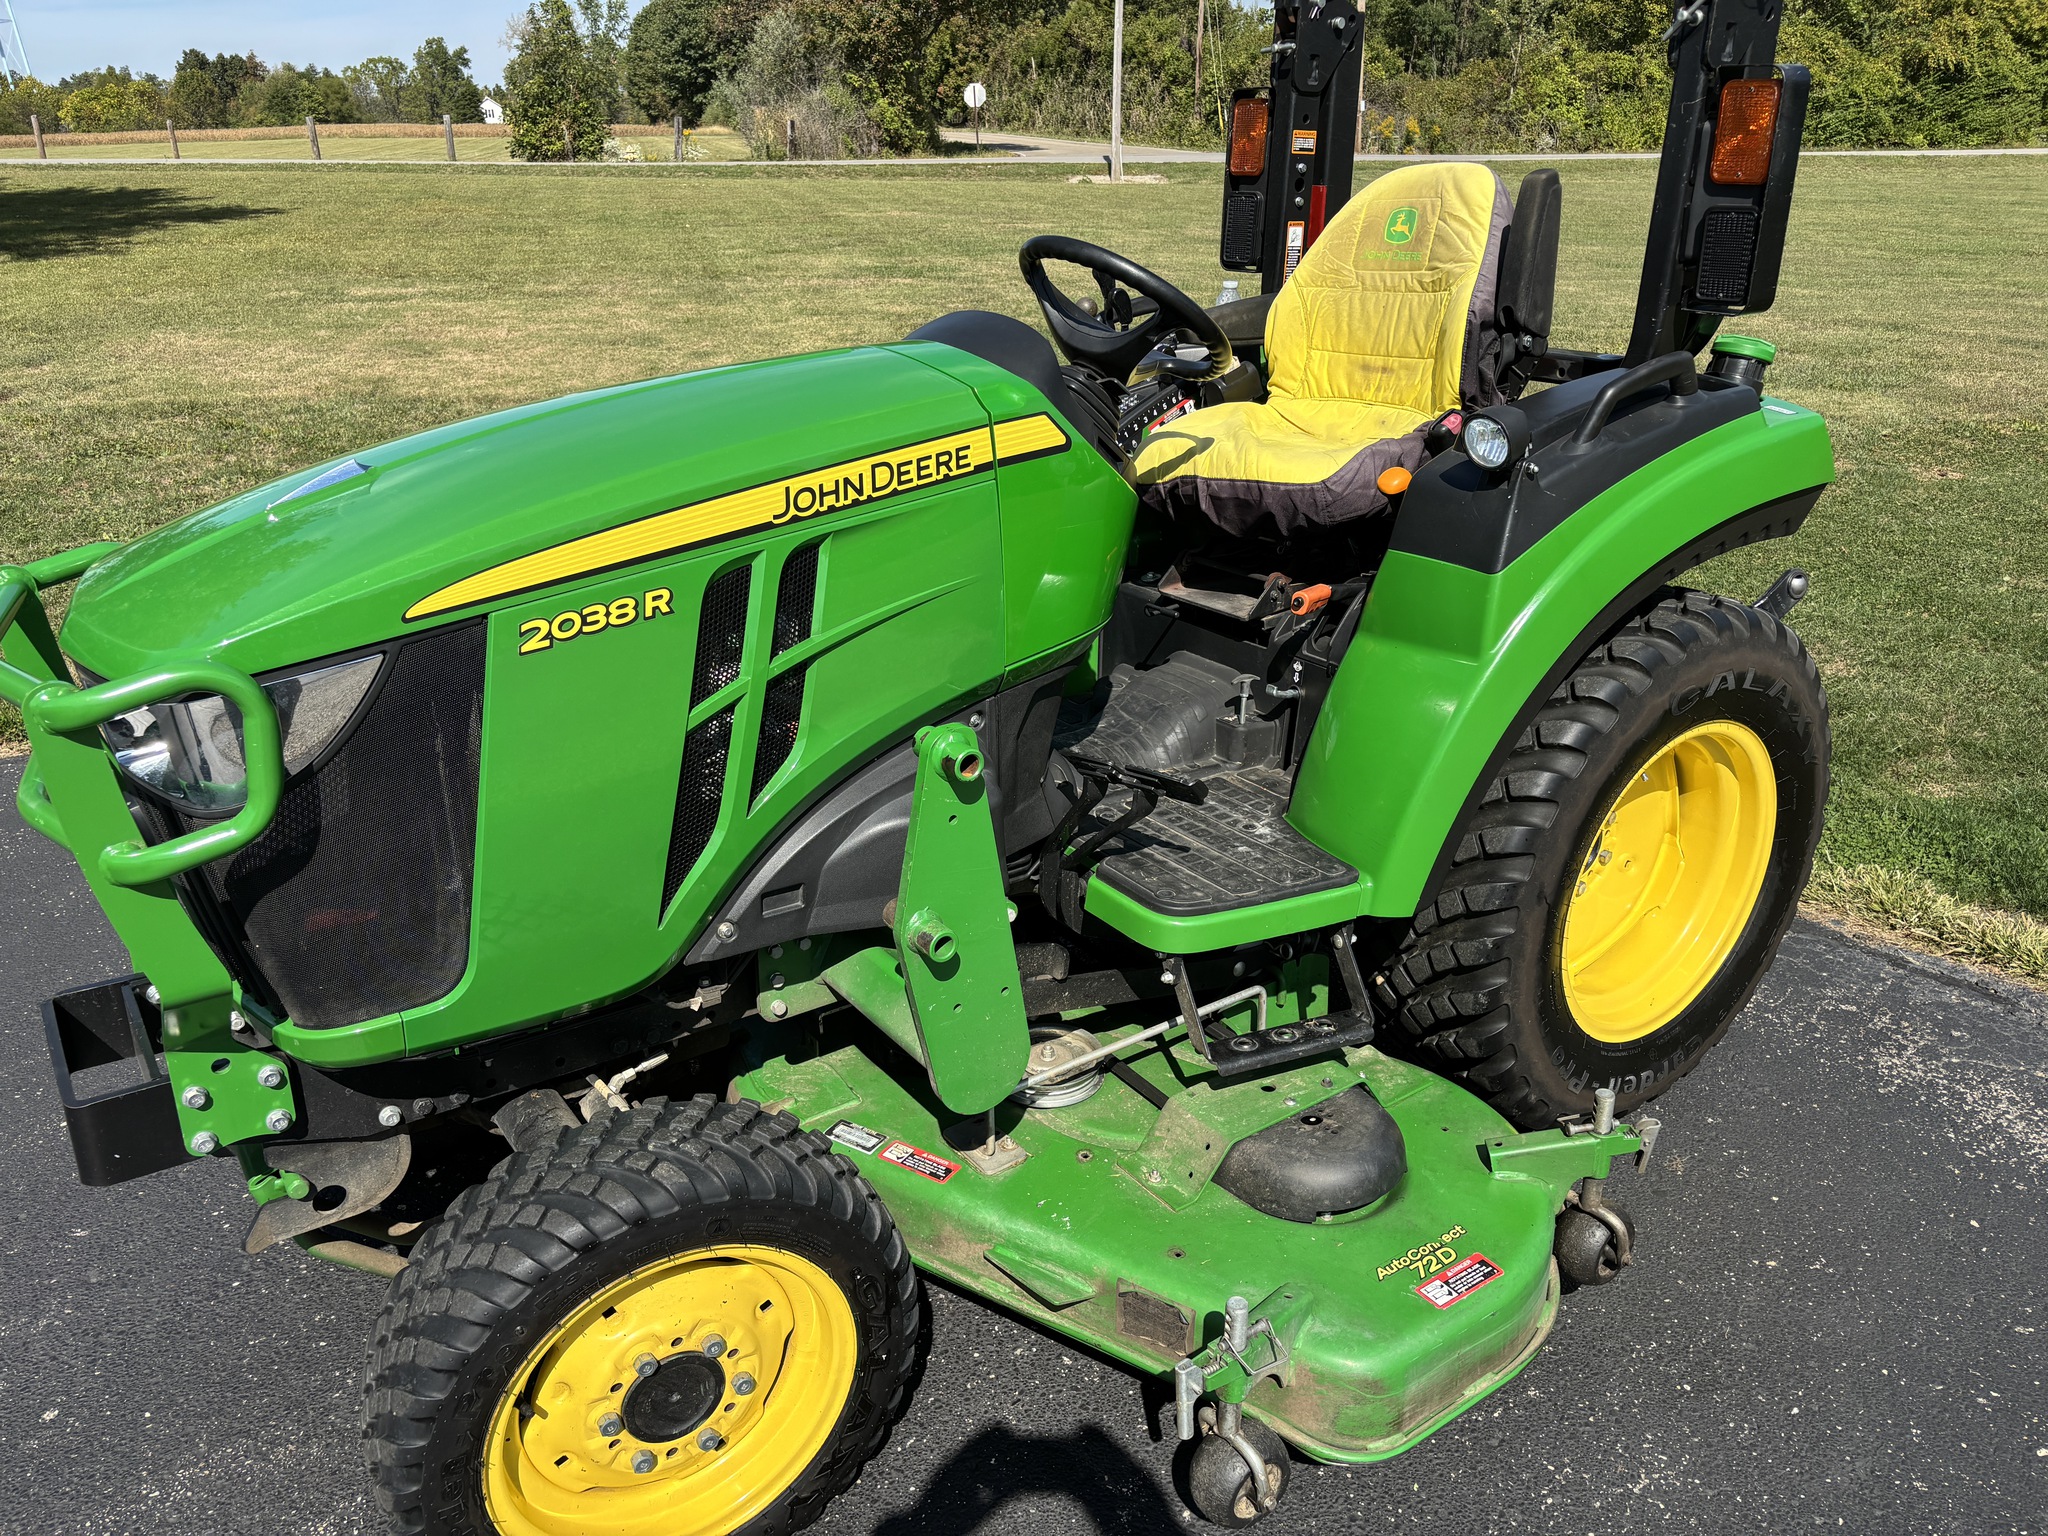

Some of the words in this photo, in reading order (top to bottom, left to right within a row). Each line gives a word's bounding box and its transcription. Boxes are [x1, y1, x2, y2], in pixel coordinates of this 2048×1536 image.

[1361, 249, 1391, 260] JOHN
[1392, 249, 1423, 261] DEERE
[1133, 423, 1139, 431] 2
[1143, 416, 1149, 424] 3
[1162, 402, 1168, 410] 5
[1171, 396, 1177, 404] 6
[772, 472, 865, 522] JOHN
[870, 444, 972, 495] DEERE
[1671, 666, 1821, 766] GALAXY
[1408, 1245, 1458, 1280] 72D
[1449, 1259, 1473, 1274] DANGER
[784, 1273, 891, 1525] GALAXY
